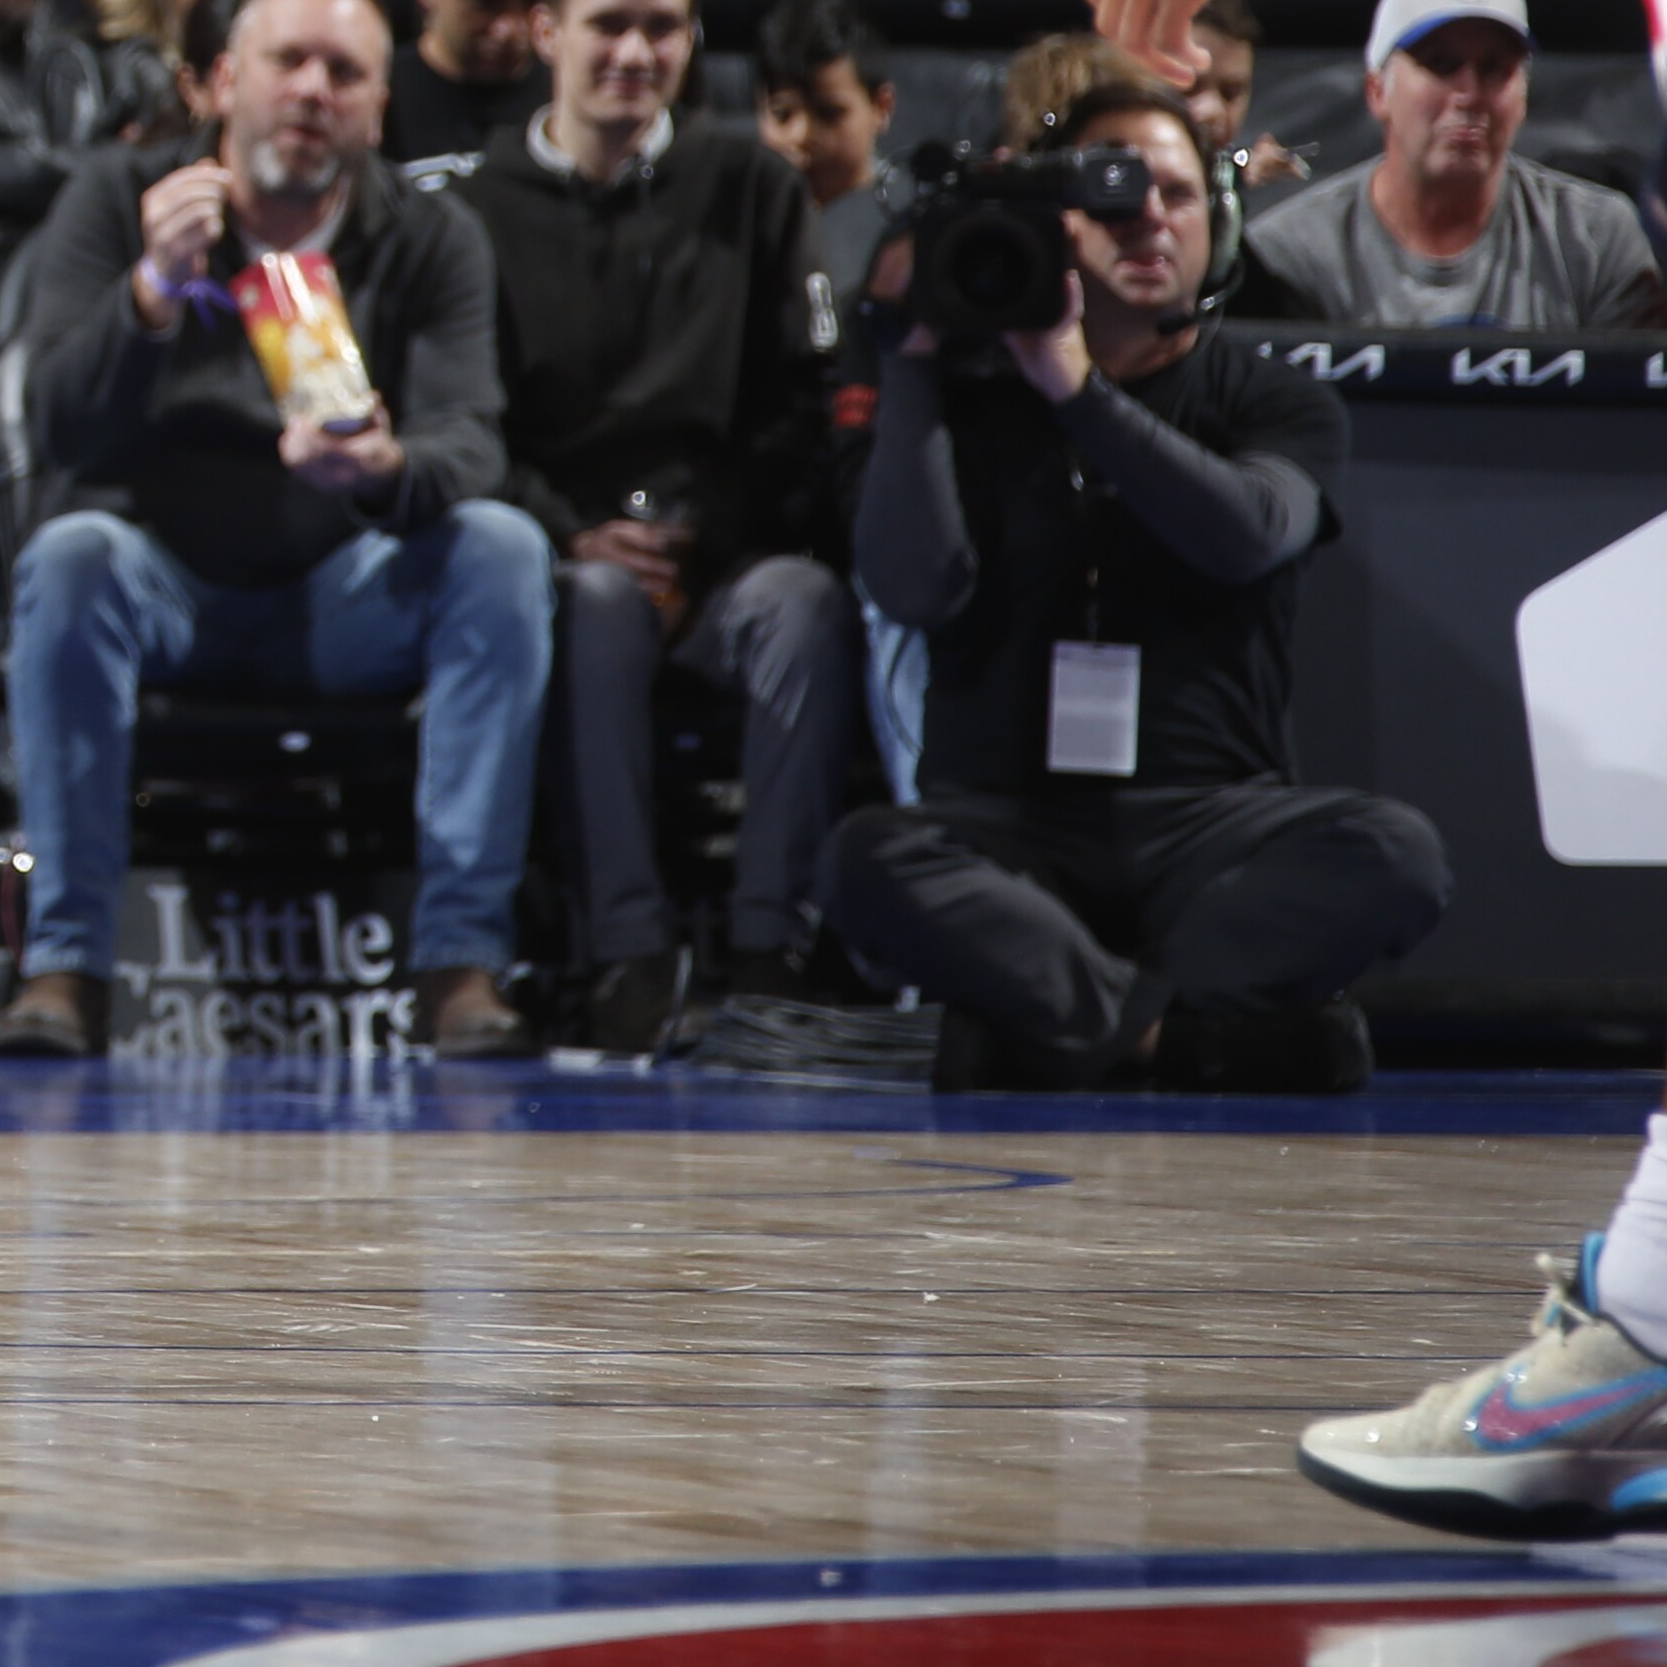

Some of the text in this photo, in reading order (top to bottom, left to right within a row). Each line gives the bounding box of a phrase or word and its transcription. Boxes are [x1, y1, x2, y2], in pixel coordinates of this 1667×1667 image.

[1258, 342, 1585, 387] IA KIA
[145, 883, 396, 986] Little
